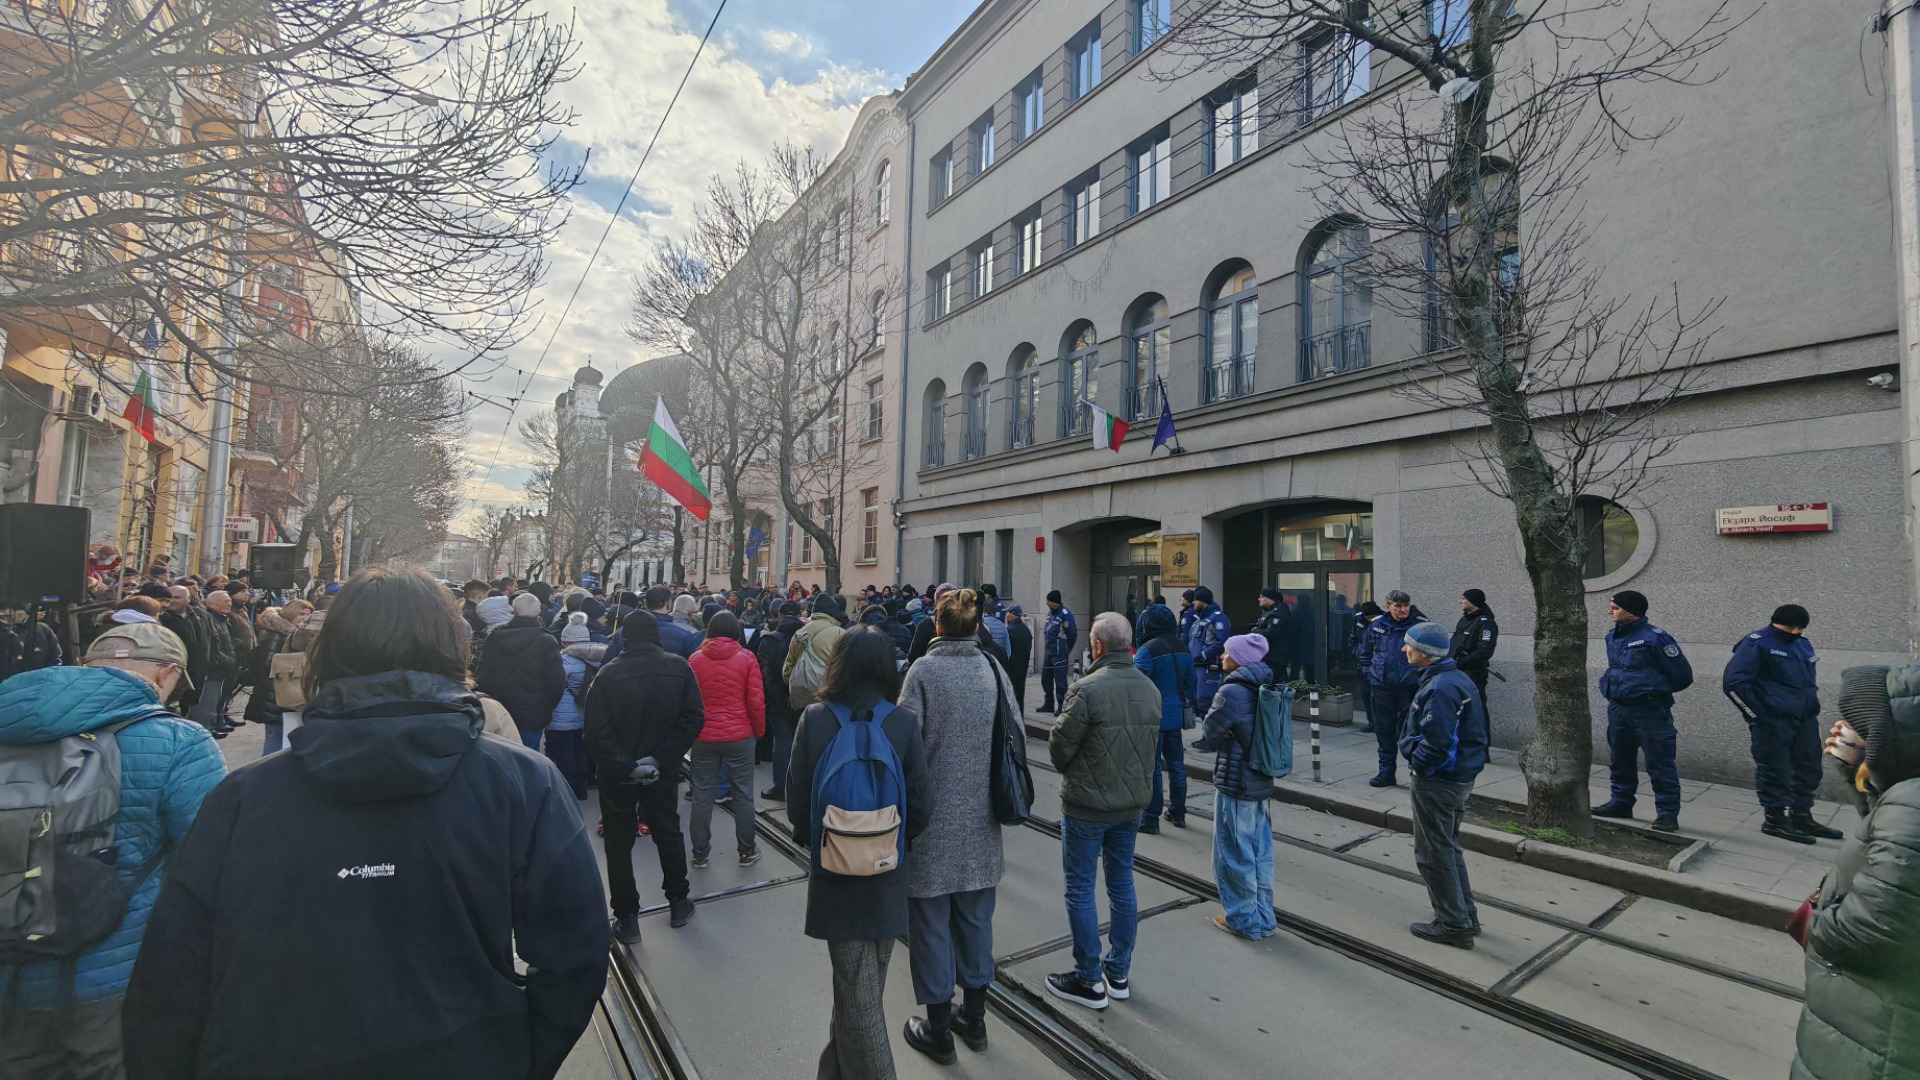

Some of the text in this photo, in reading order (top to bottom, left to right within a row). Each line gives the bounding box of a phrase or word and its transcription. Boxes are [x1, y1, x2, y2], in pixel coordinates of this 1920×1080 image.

[1722, 514, 1795, 525] Екзарх Йосиф
[350, 863, 395, 876] Columbia
[361, 871, 395, 879] TITANIUM
